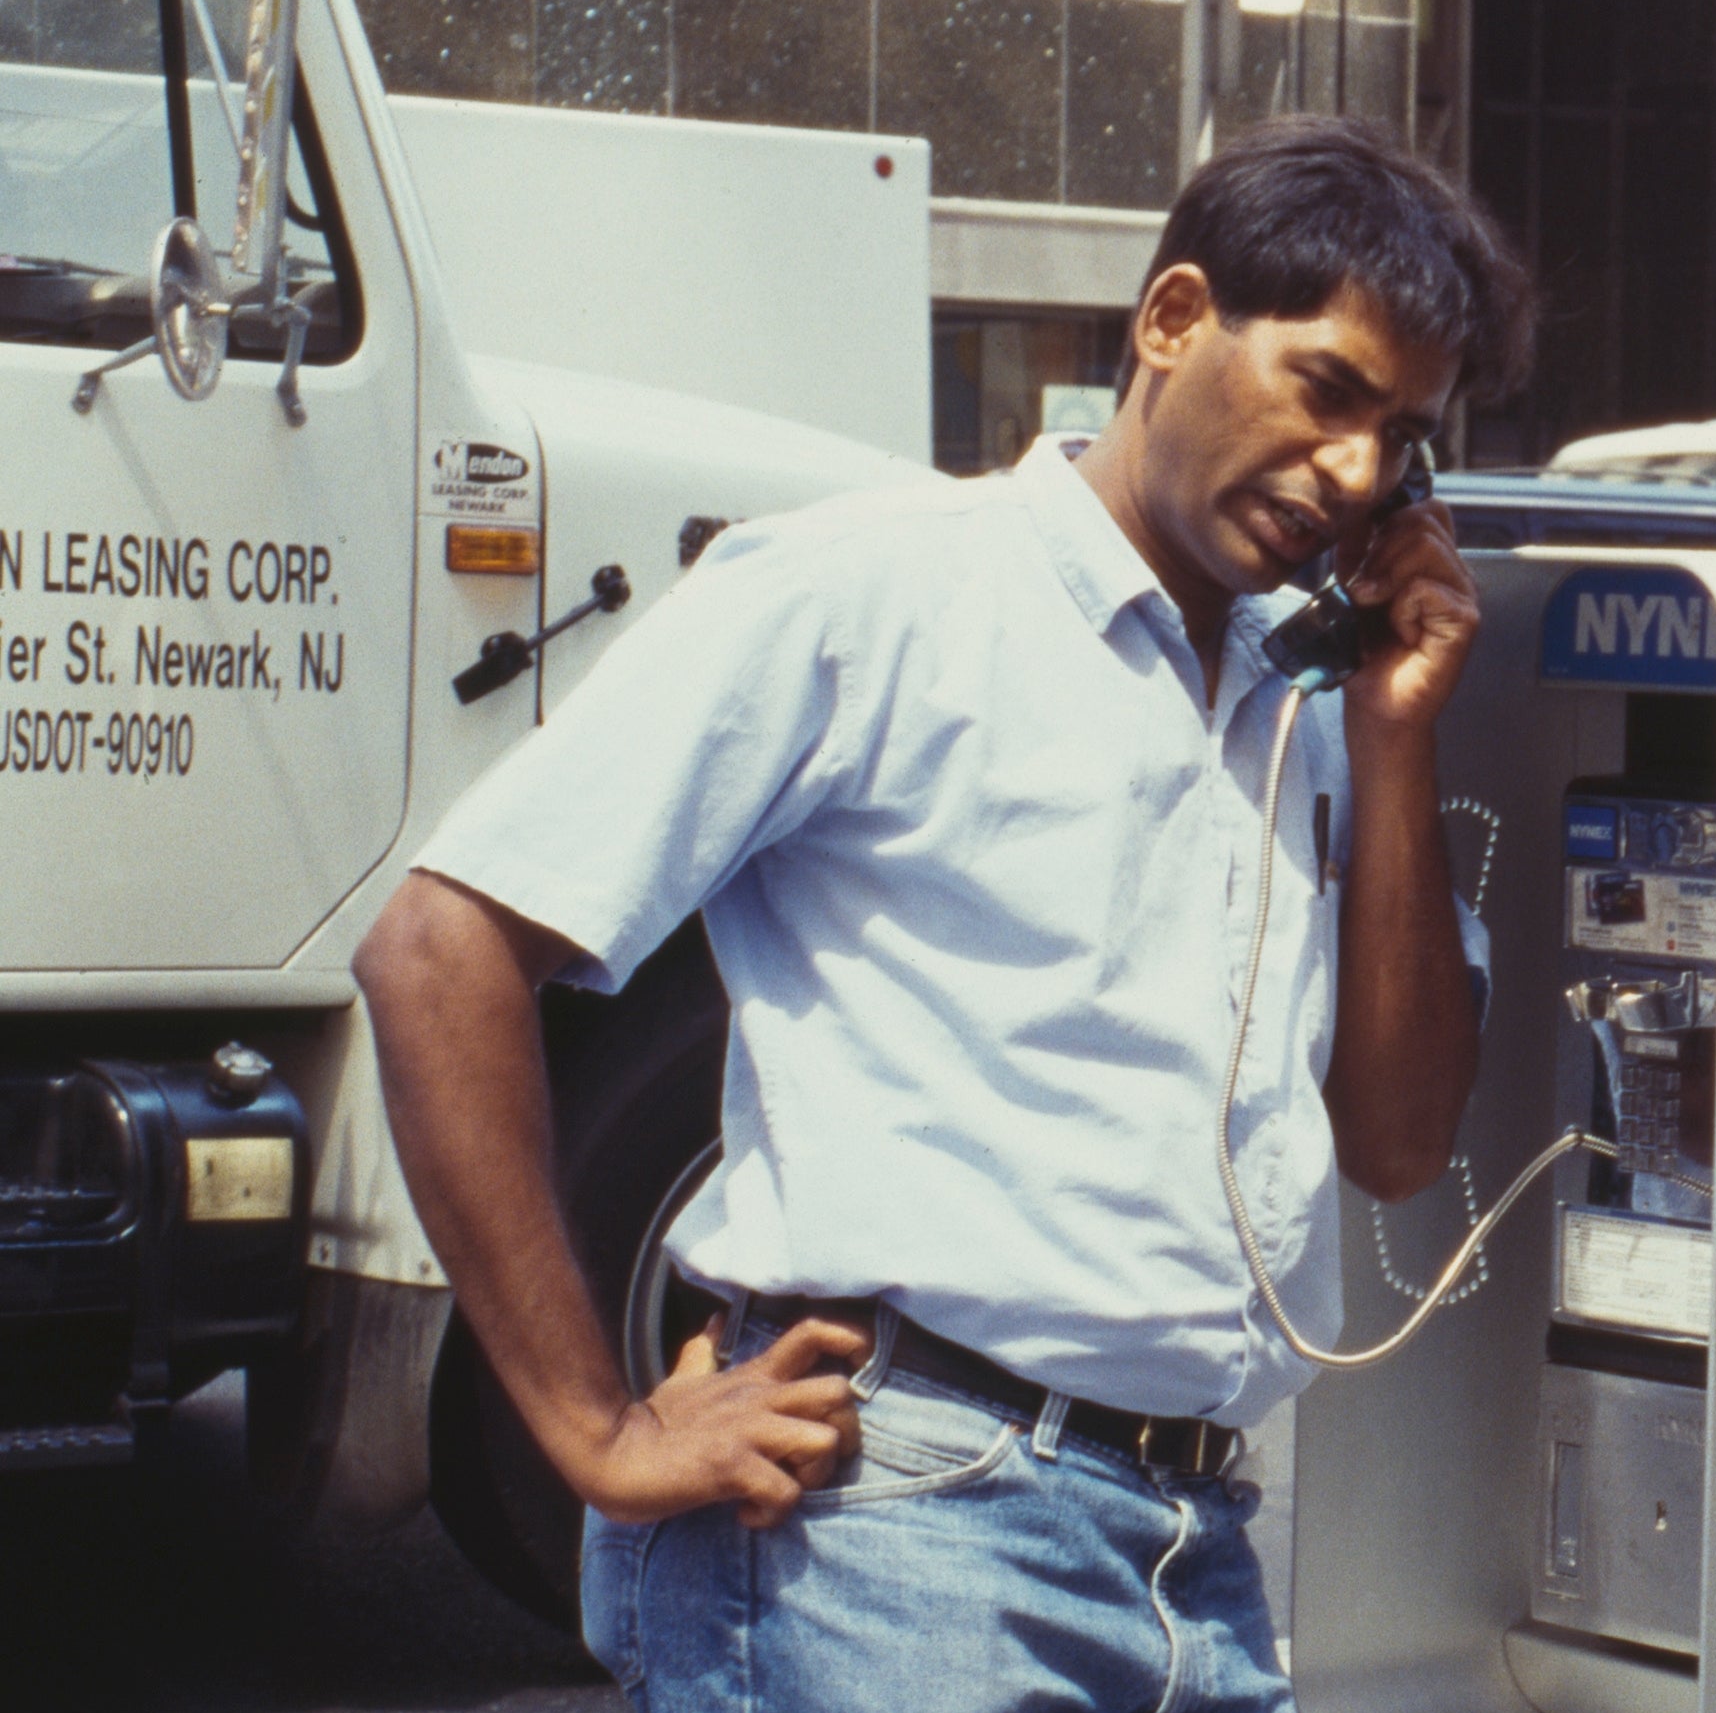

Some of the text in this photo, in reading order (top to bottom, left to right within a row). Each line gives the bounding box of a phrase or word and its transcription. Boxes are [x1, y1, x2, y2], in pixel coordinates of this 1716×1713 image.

[438, 439, 525, 482] Mendon
[431, 483, 487, 498] LEASING
[448, 499, 505, 513] NEWARK
[43, 531, 210, 601] LEASING
[227, 539, 339, 606] CORP.
[65, 619, 115, 685] St.
[136, 624, 281, 703] Newark,
[299, 630, 344, 694] NJ
